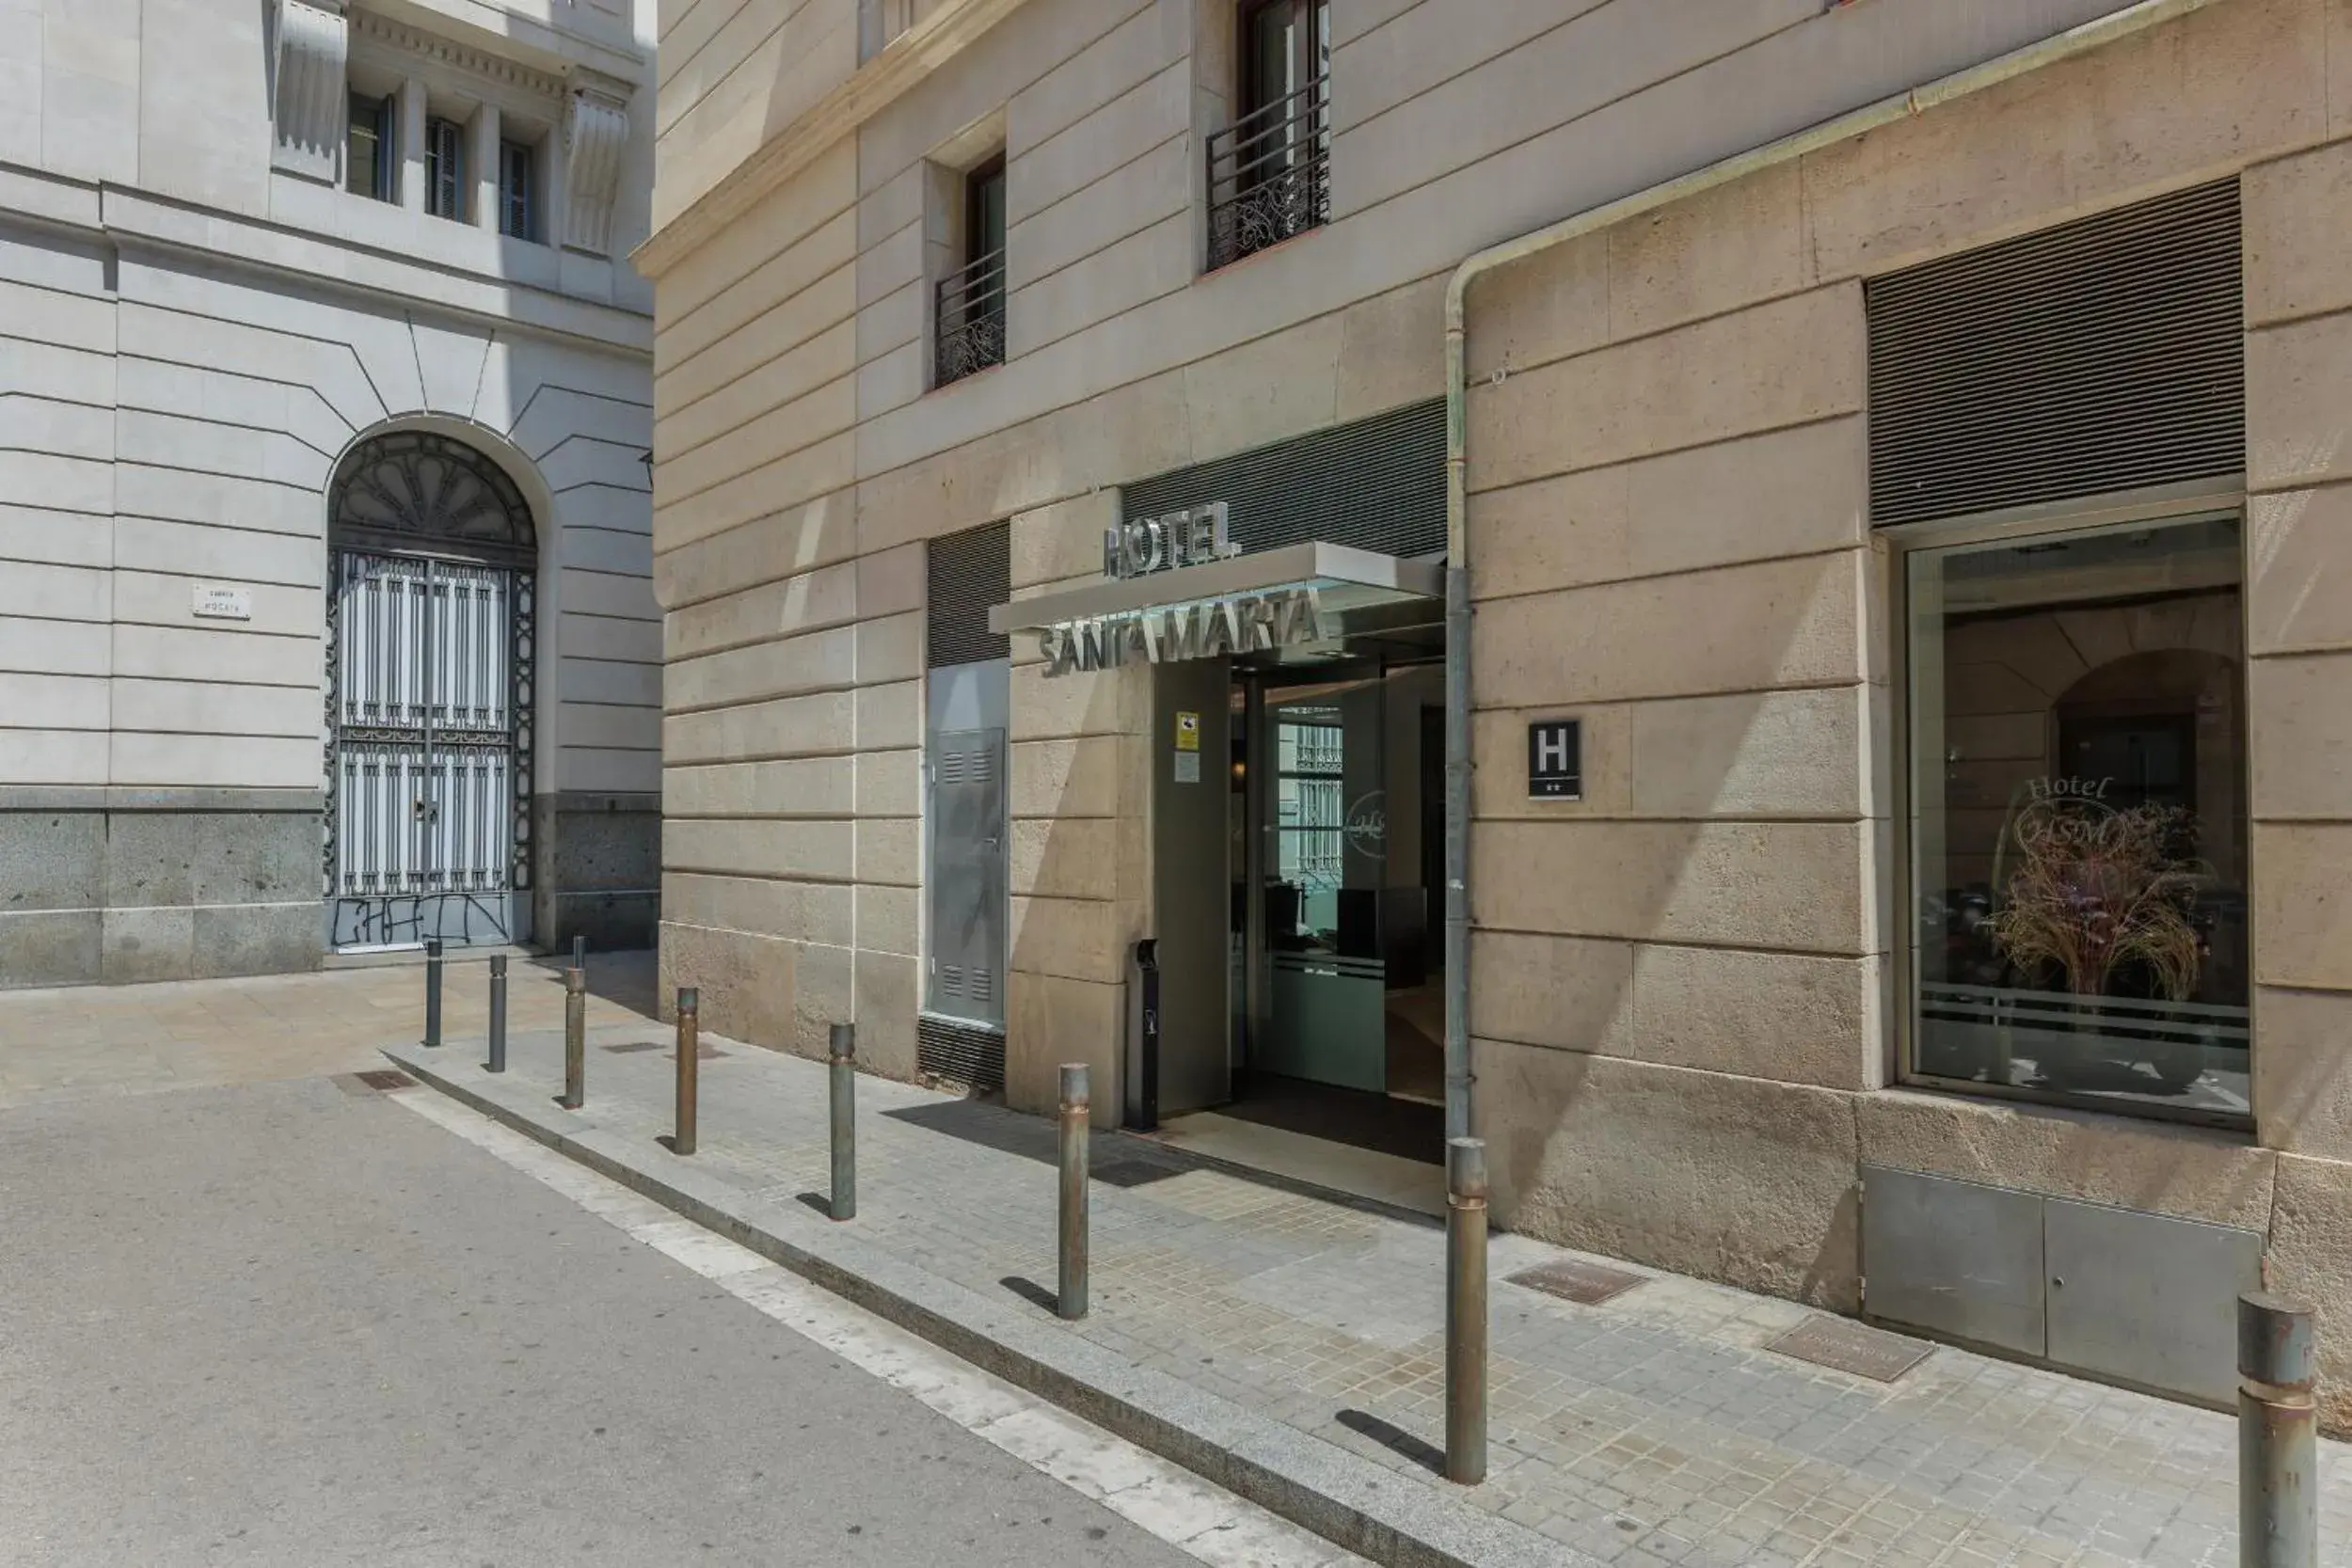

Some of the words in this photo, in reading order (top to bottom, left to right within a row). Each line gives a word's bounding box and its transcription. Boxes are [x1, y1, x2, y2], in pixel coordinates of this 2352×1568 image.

[1104, 501, 1243, 580] HOTEL
[1040, 615, 1160, 678] SANTA
[1164, 588, 1320, 662] MARIA
[1537, 728, 1566, 771] H
[2025, 774, 2115, 800] Hotel
